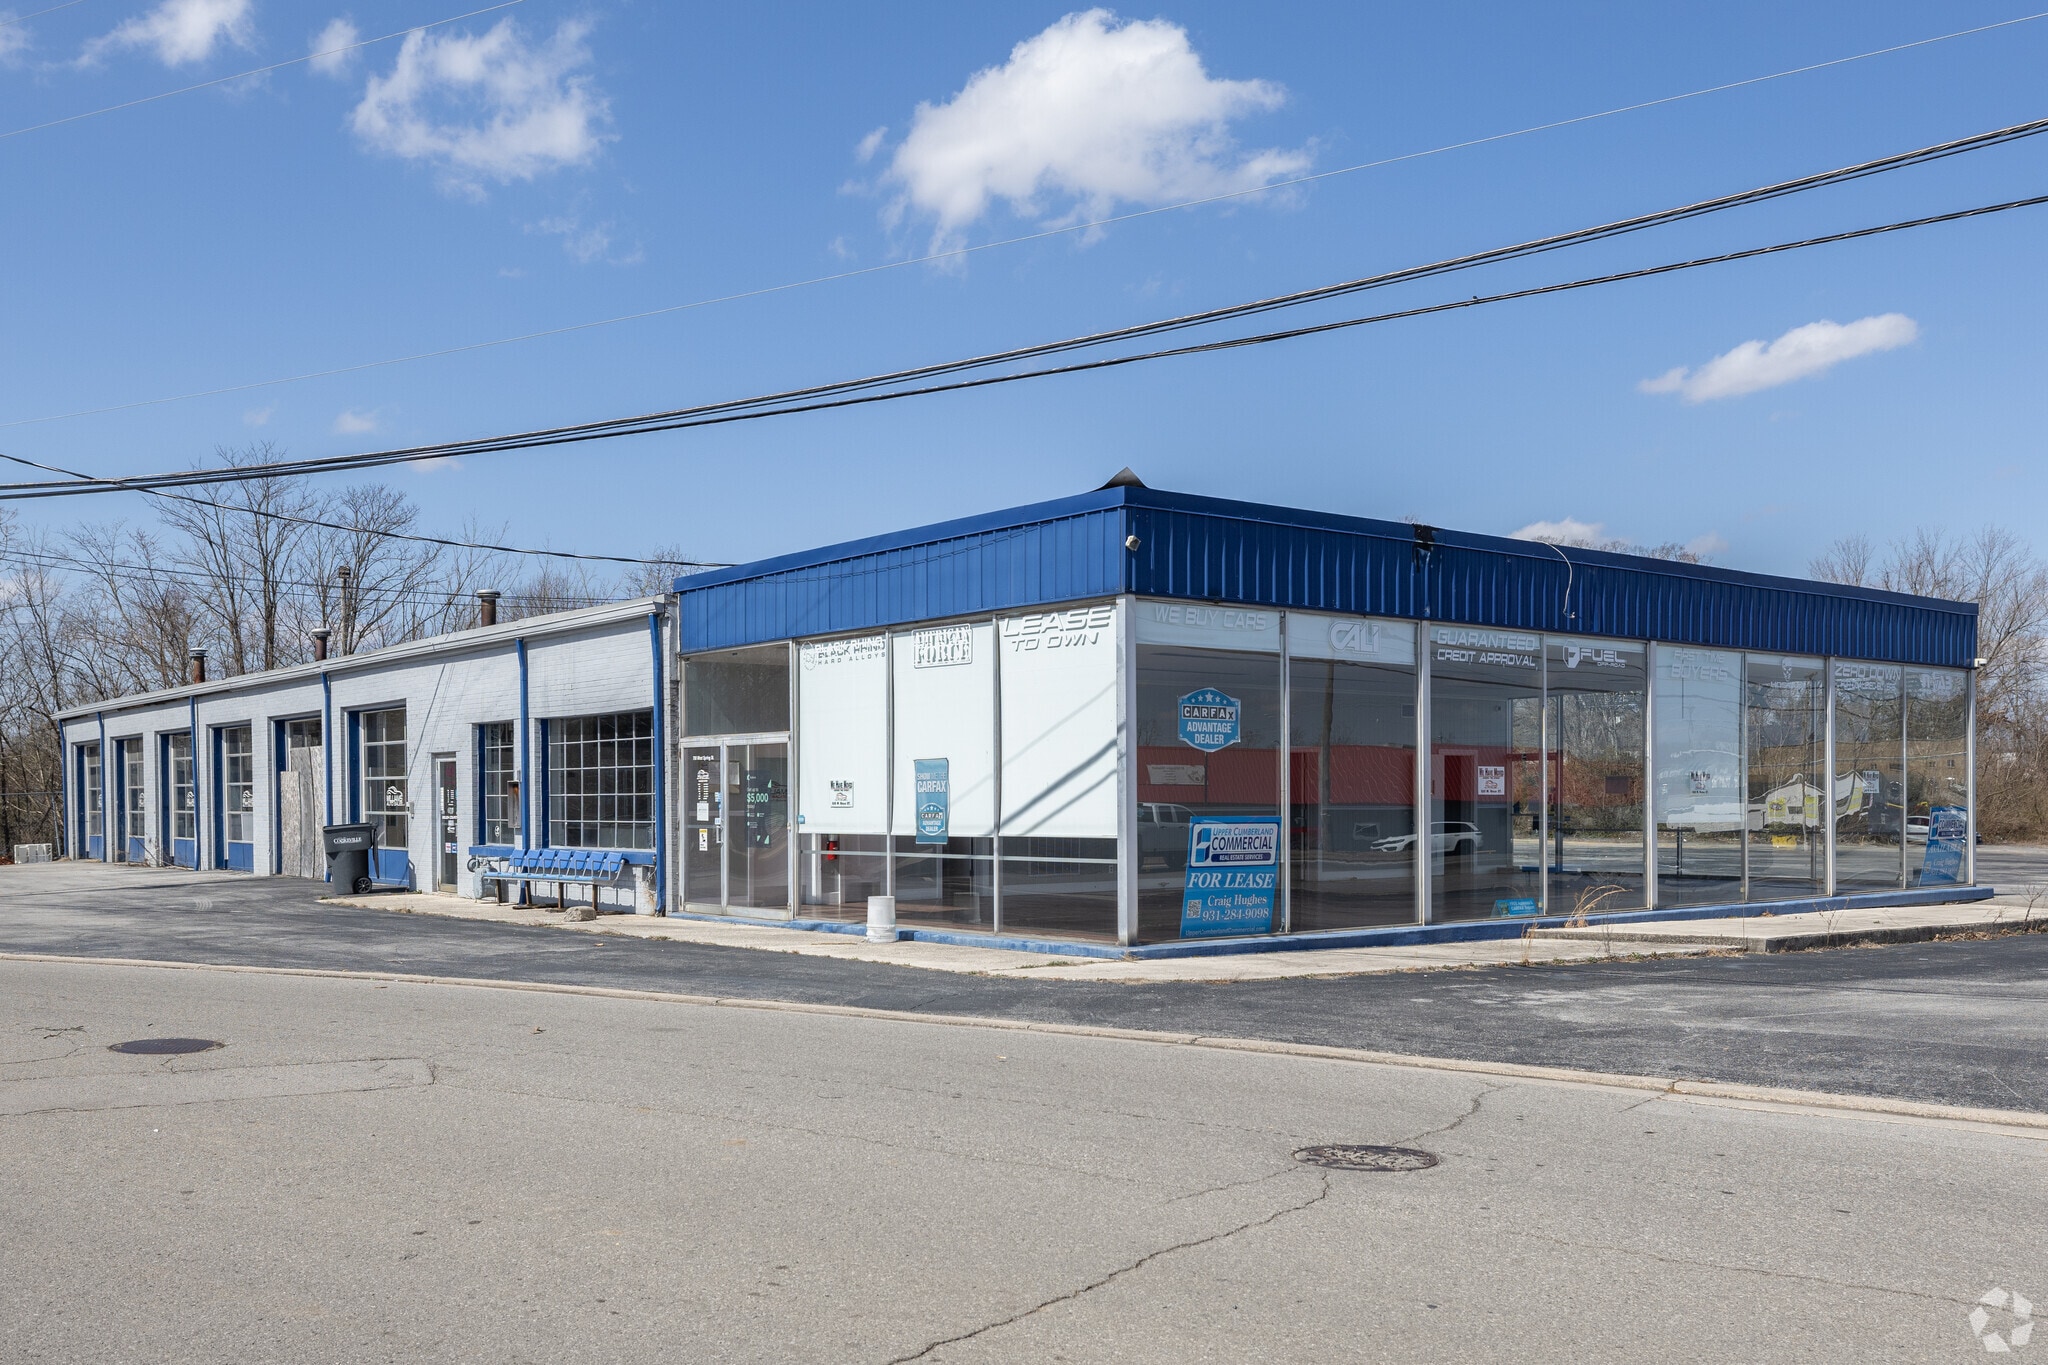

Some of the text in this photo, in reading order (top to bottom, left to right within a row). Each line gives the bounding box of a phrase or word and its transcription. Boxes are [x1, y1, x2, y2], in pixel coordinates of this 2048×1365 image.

[1003, 606, 1111, 637] LEASE
[1155, 606, 1268, 630] WE BUY CARS
[1011, 632, 1099, 652] TO OWN
[1329, 621, 1380, 653] CALI
[1437, 630, 1536, 651] GUARANTEED
[818, 652, 886, 665] HARD ALLOYS
[1437, 649, 1536, 667] CREDIT APPROVAL
[1580, 648, 1627, 663] FUEL
[1671, 663, 1728, 681] BUYERS
[1835, 663, 1902, 681] ZERO DOWN
[1184, 707, 1234, 720] CARFAX
[1187, 721, 1232, 733] ADVANTAGE
[1195, 733, 1225, 744] DEALER
[917, 781, 946, 793] CARFAX
[746, 793, 769, 804] $5,000
[1213, 827, 1274, 837] UPPER CUMBERLAND
[1211, 836, 1273, 851] COMMERCIAL
[1187, 872, 1275, 888] FOR LEASE
[1207, 894, 1267, 908] Craig Hughes
[1202, 908, 1270, 922] 931-284-9098
